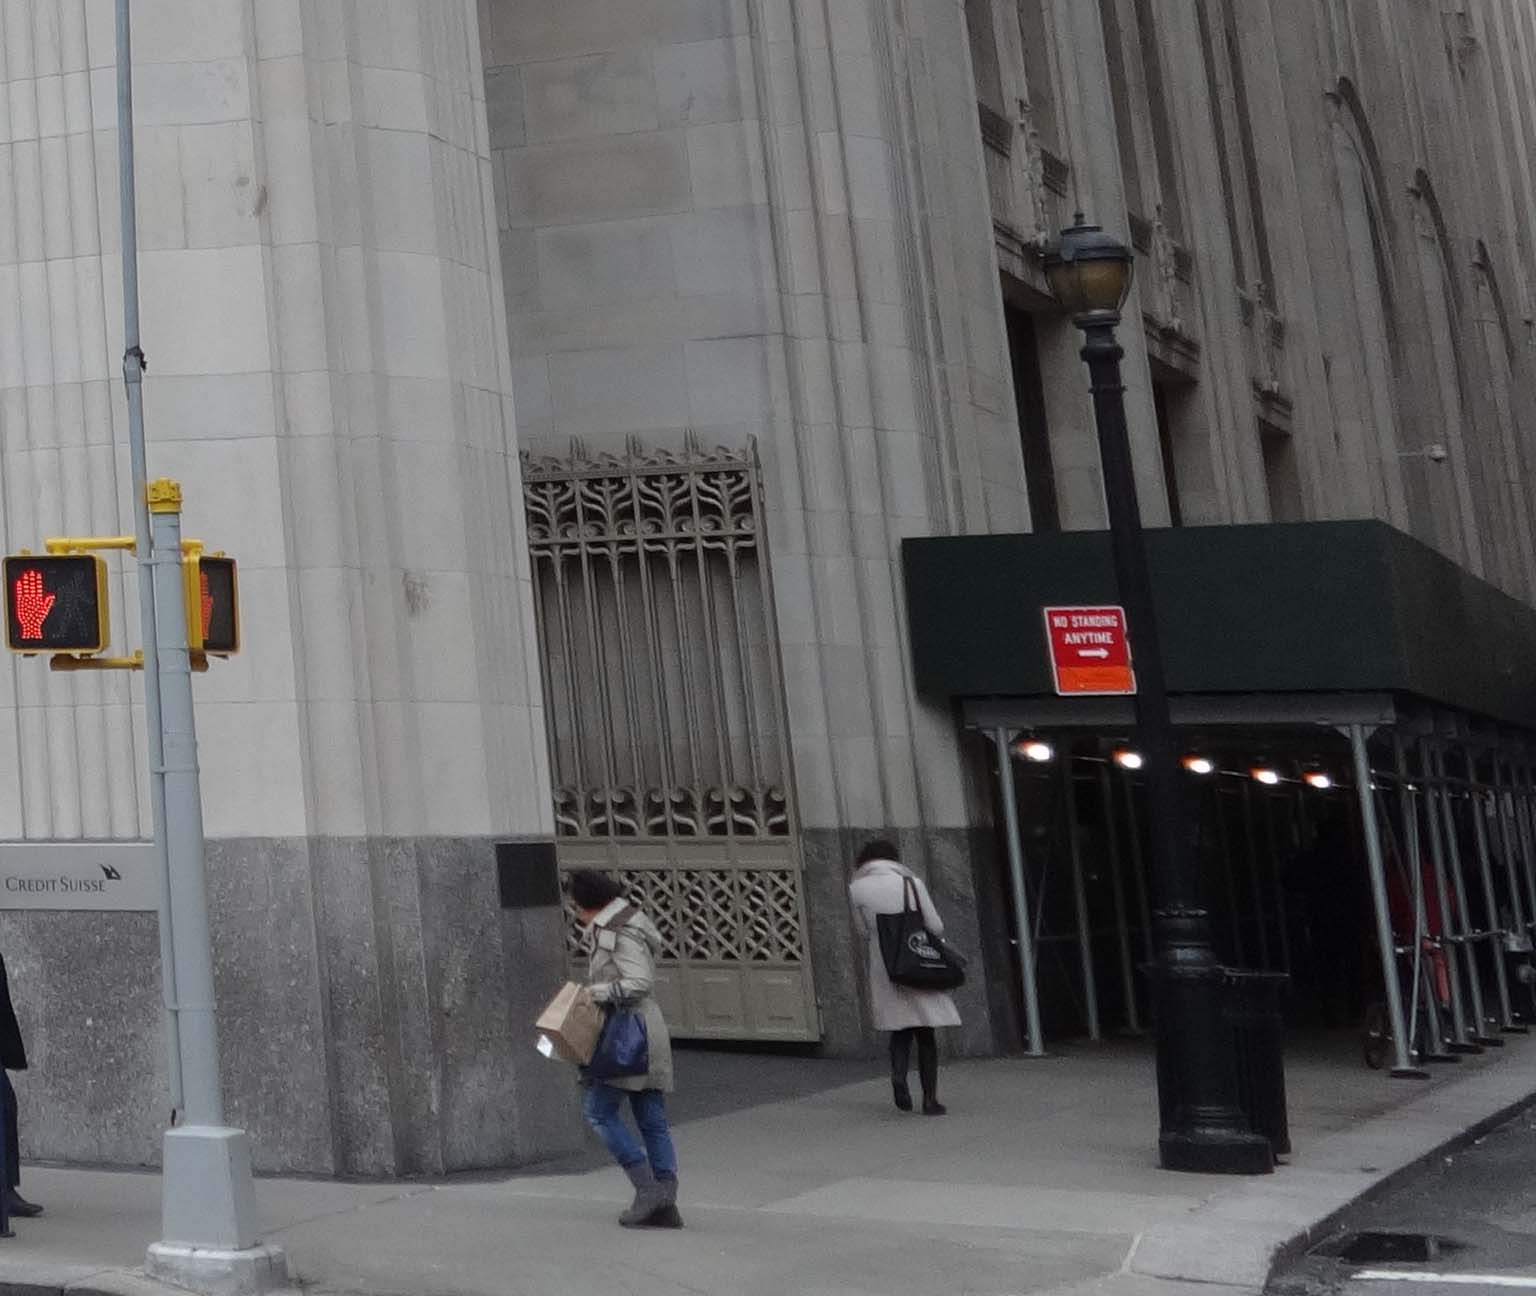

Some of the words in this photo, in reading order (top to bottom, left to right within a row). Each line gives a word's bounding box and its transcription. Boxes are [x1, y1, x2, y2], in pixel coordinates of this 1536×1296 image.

[1053, 615, 1068, 628] NO
[1071, 615, 1118, 628] STANDING
[1064, 631, 1114, 645] ANYTIME
[5, 876, 57, 892] CREDIT
[59, 875, 106, 892] SUISSE
